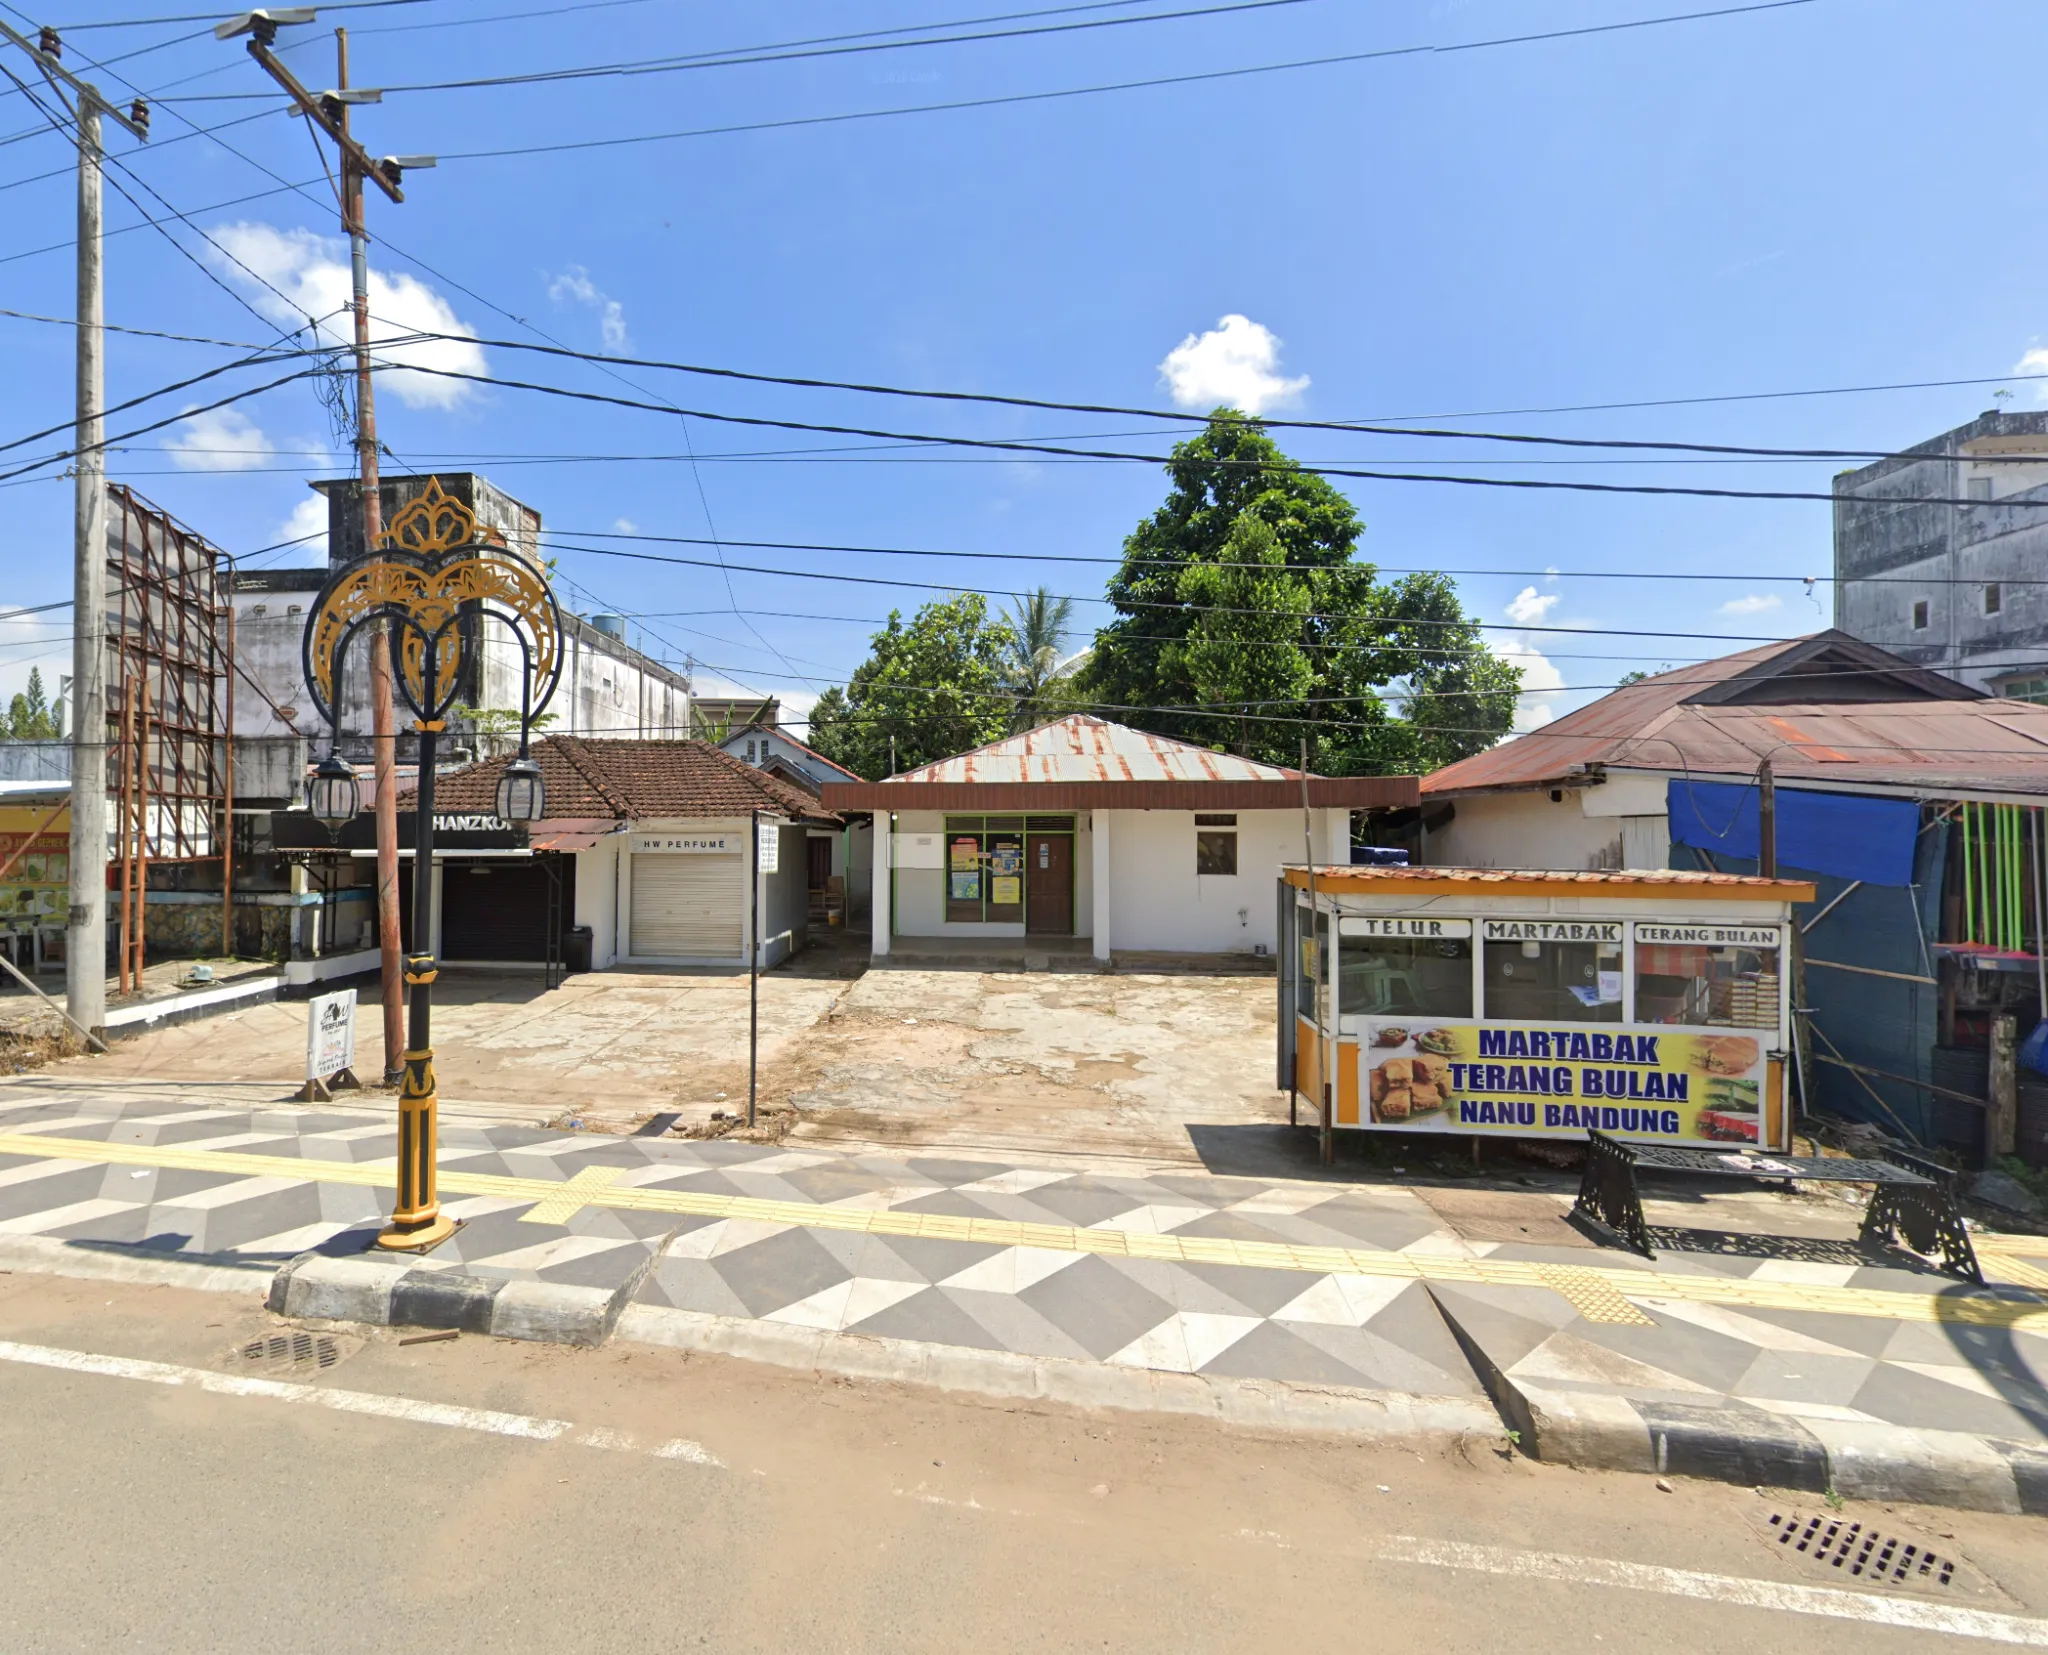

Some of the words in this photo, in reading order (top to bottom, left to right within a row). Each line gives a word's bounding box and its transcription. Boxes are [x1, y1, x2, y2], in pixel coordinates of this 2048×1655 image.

[433, 815, 512, 831] HANZKO
[643, 840, 660, 848] HW
[667, 840, 725, 848] PERFUME
[1365, 918, 1444, 936] TELUR
[1487, 921, 1618, 941] MARTABAK
[1639, 926, 1709, 941] TERANG
[1714, 928, 1775, 944] BULAN
[321, 1019, 348, 1032] PERFUME
[1479, 1030, 1660, 1065] MARTABAK
[1447, 1063, 1574, 1096] TERANG
[1580, 1067, 1690, 1102] BULAN
[1460, 1099, 1536, 1127] NANU
[1544, 1102, 1681, 1134] BANDUNG
